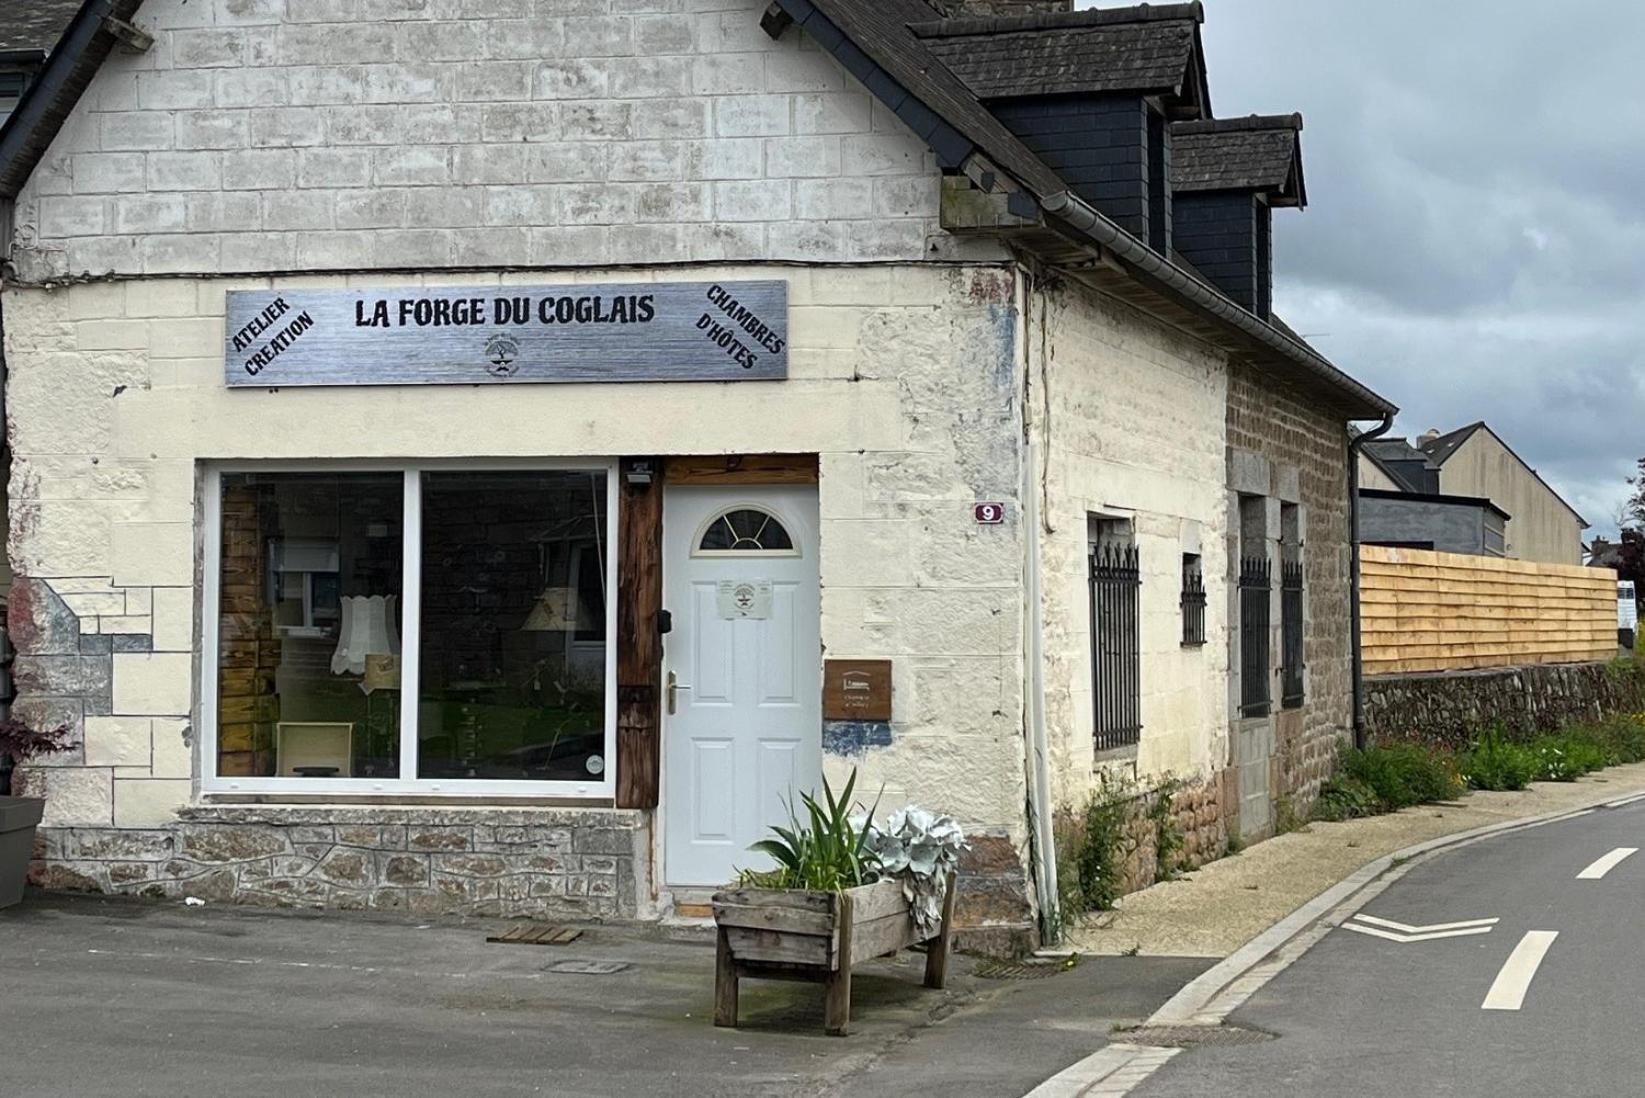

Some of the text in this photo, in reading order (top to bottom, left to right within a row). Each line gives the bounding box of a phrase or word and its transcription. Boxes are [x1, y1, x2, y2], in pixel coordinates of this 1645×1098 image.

[232, 297, 290, 352] ATELIER
[355, 295, 655, 327] LA FORGE DU COGLAIS
[707, 285, 785, 354] CHAMBRES
[245, 310, 314, 376] CREATION
[696, 313, 758, 369] D'HÔTES
[982, 506, 994, 520] 9
